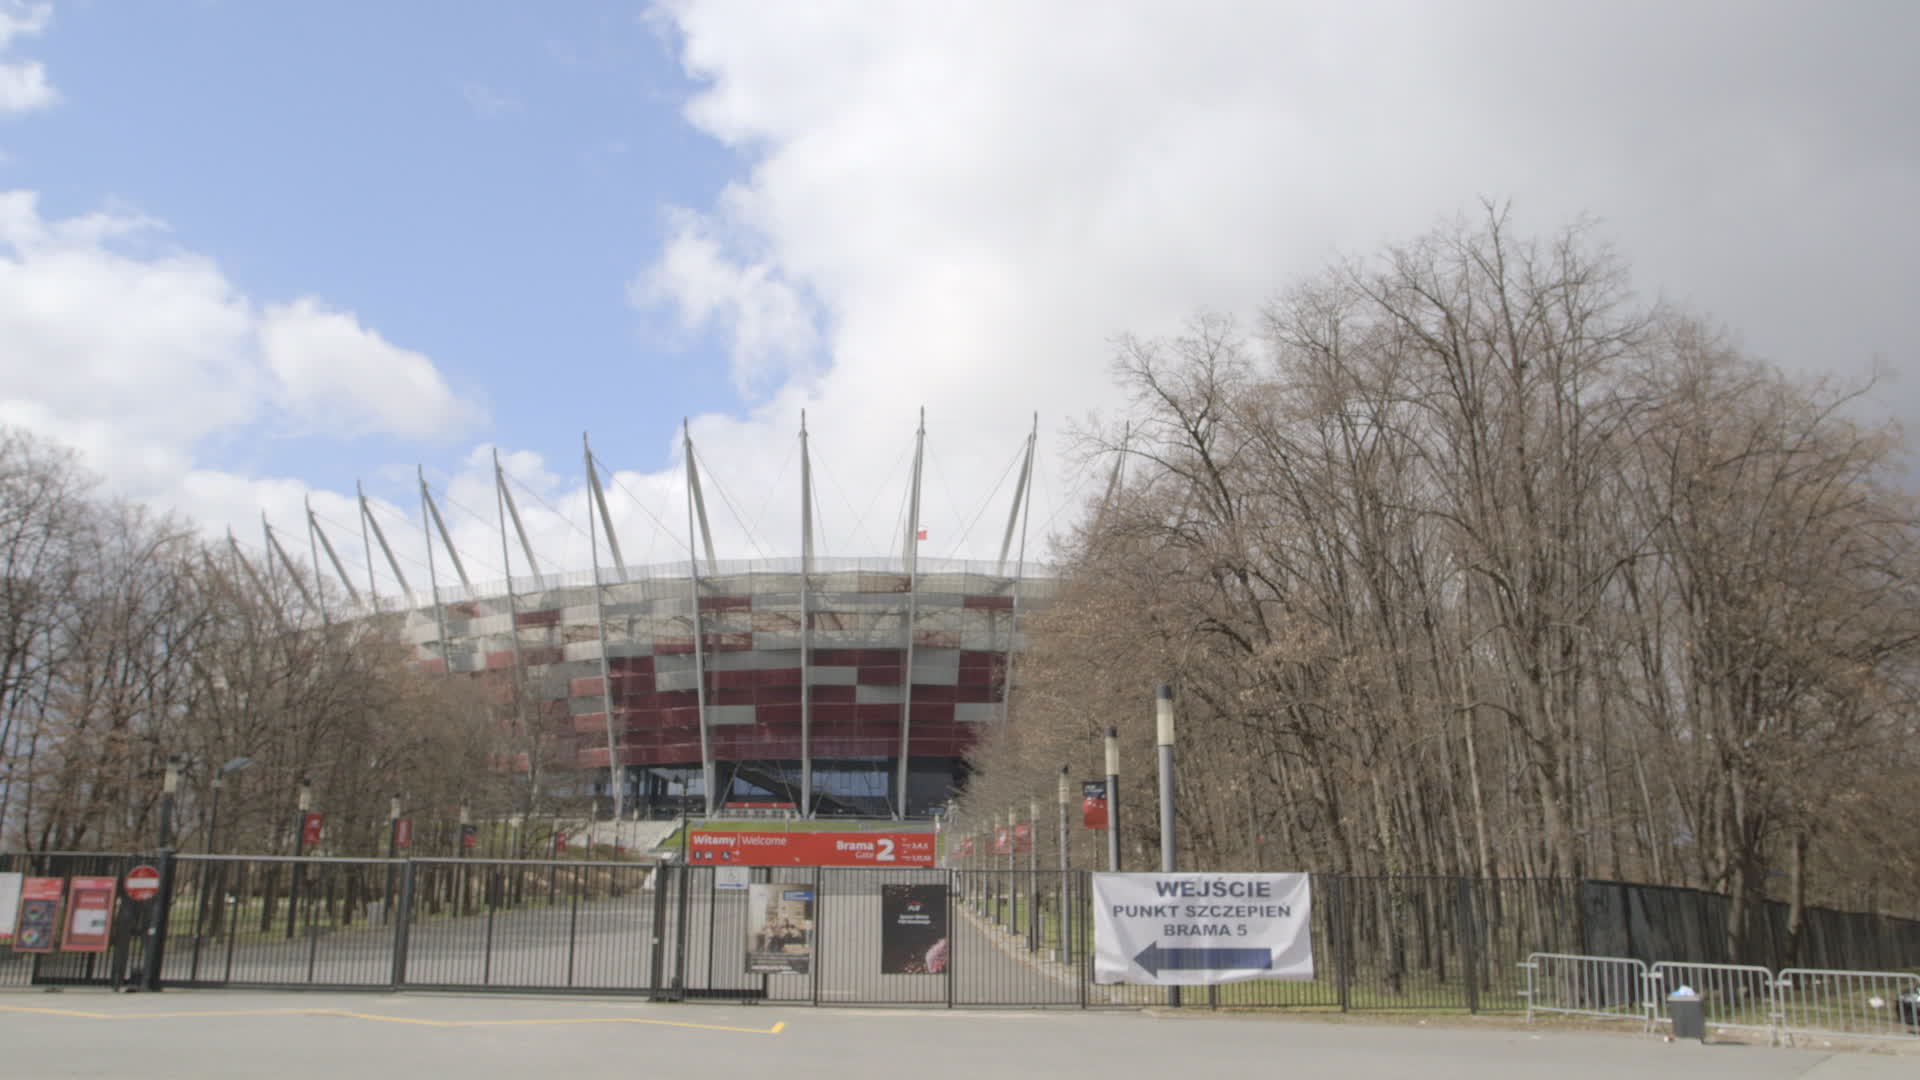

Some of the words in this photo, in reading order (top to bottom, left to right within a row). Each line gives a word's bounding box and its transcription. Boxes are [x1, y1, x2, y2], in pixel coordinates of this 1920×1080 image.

[693, 834, 736, 847] Witamy
[742, 835, 787, 846] Welcome
[836, 840, 874, 851] Brama
[876, 838, 896, 861] 2
[1156, 877, 1272, 898] WEJŚCIE
[1113, 905, 1179, 918] PUNKT
[1185, 902, 1292, 918] SZCZEPIEŃ
[1163, 924, 1231, 937] BRAMA
[1237, 924, 1248, 937] 5
